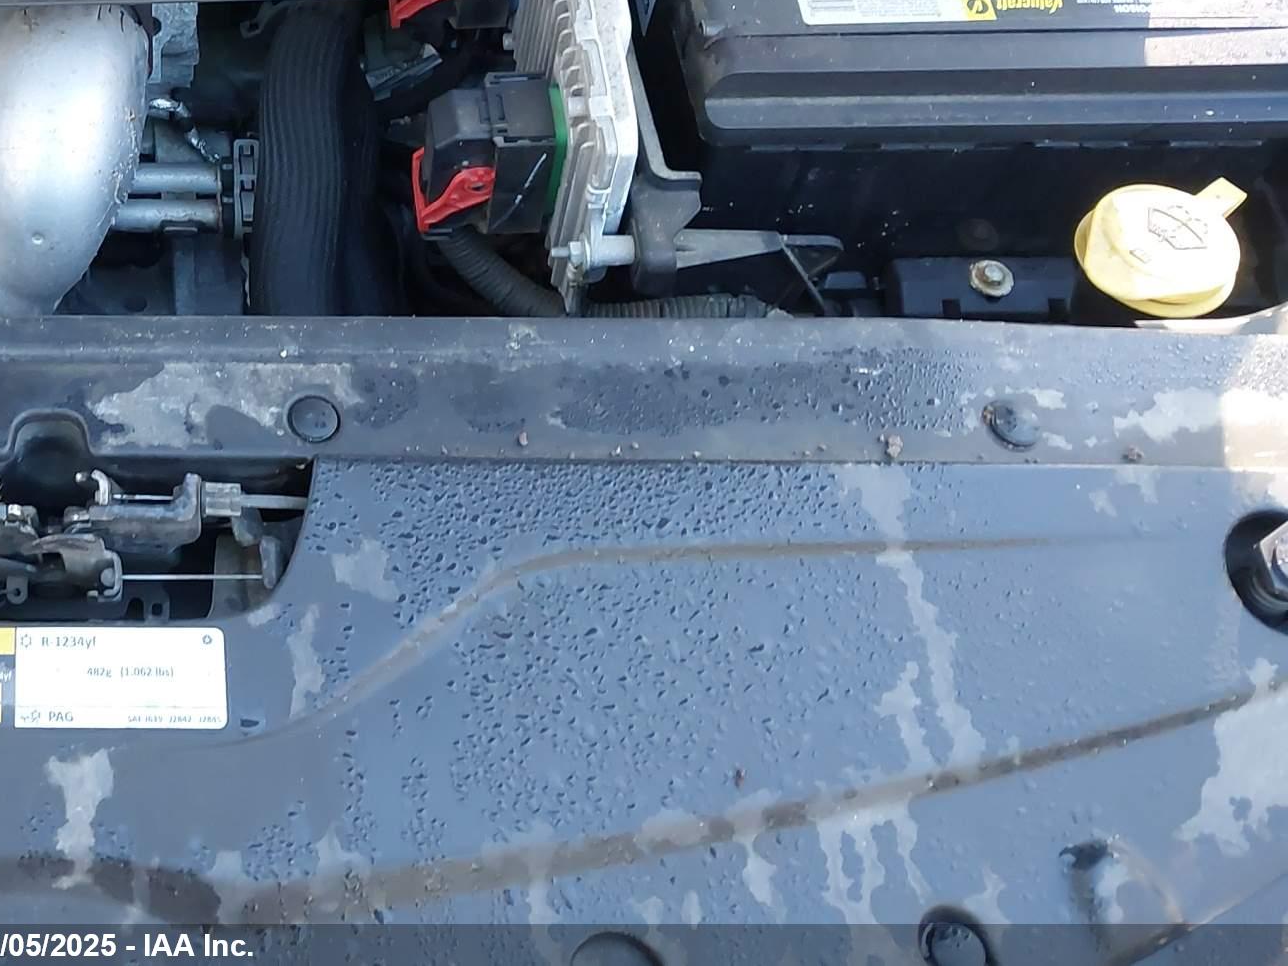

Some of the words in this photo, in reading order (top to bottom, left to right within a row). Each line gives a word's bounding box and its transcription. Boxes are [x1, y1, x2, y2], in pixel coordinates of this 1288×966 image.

[41, 636, 97, 649] R-1234yf
[87, 667, 112, 677] 482g
[48, 711, 74, 722] PAG
